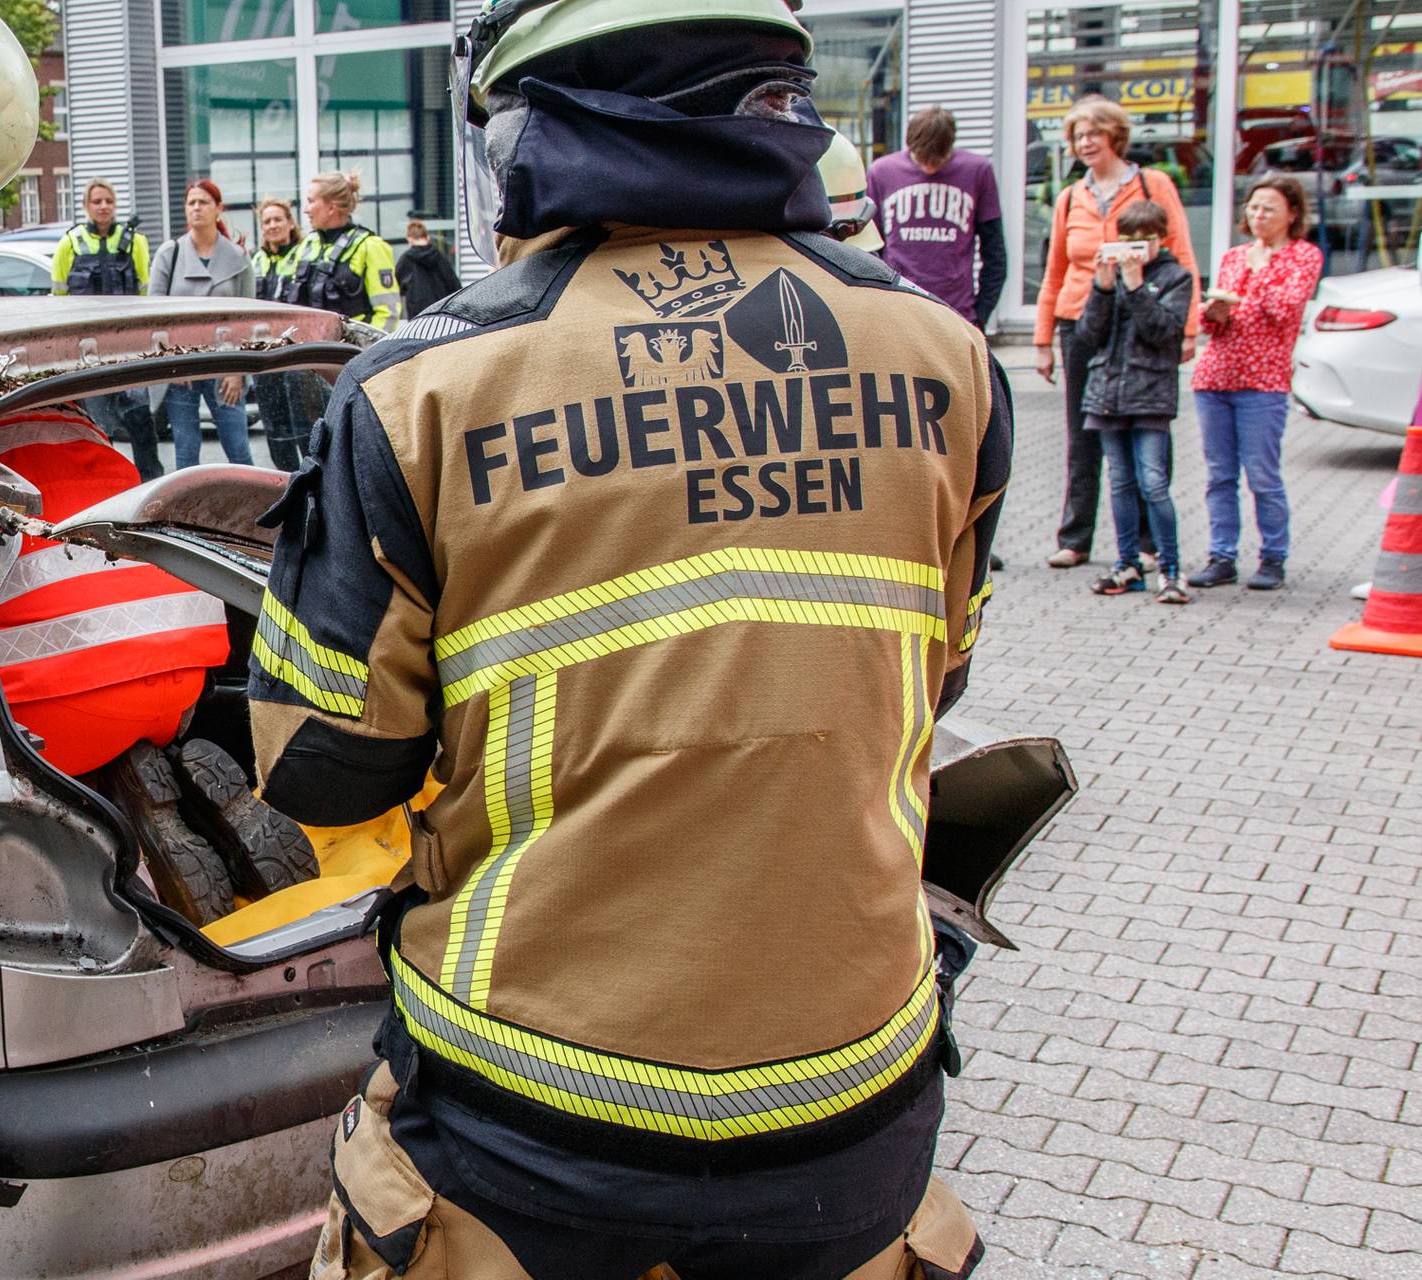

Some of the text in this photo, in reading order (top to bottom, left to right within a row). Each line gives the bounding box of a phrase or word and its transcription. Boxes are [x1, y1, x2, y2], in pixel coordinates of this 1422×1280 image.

[883, 183, 975, 235] FUTURE
[899, 227, 957, 242] VISUALS
[464, 373, 952, 506] FEUERWEHR
[686, 457, 863, 524] ESSEN
